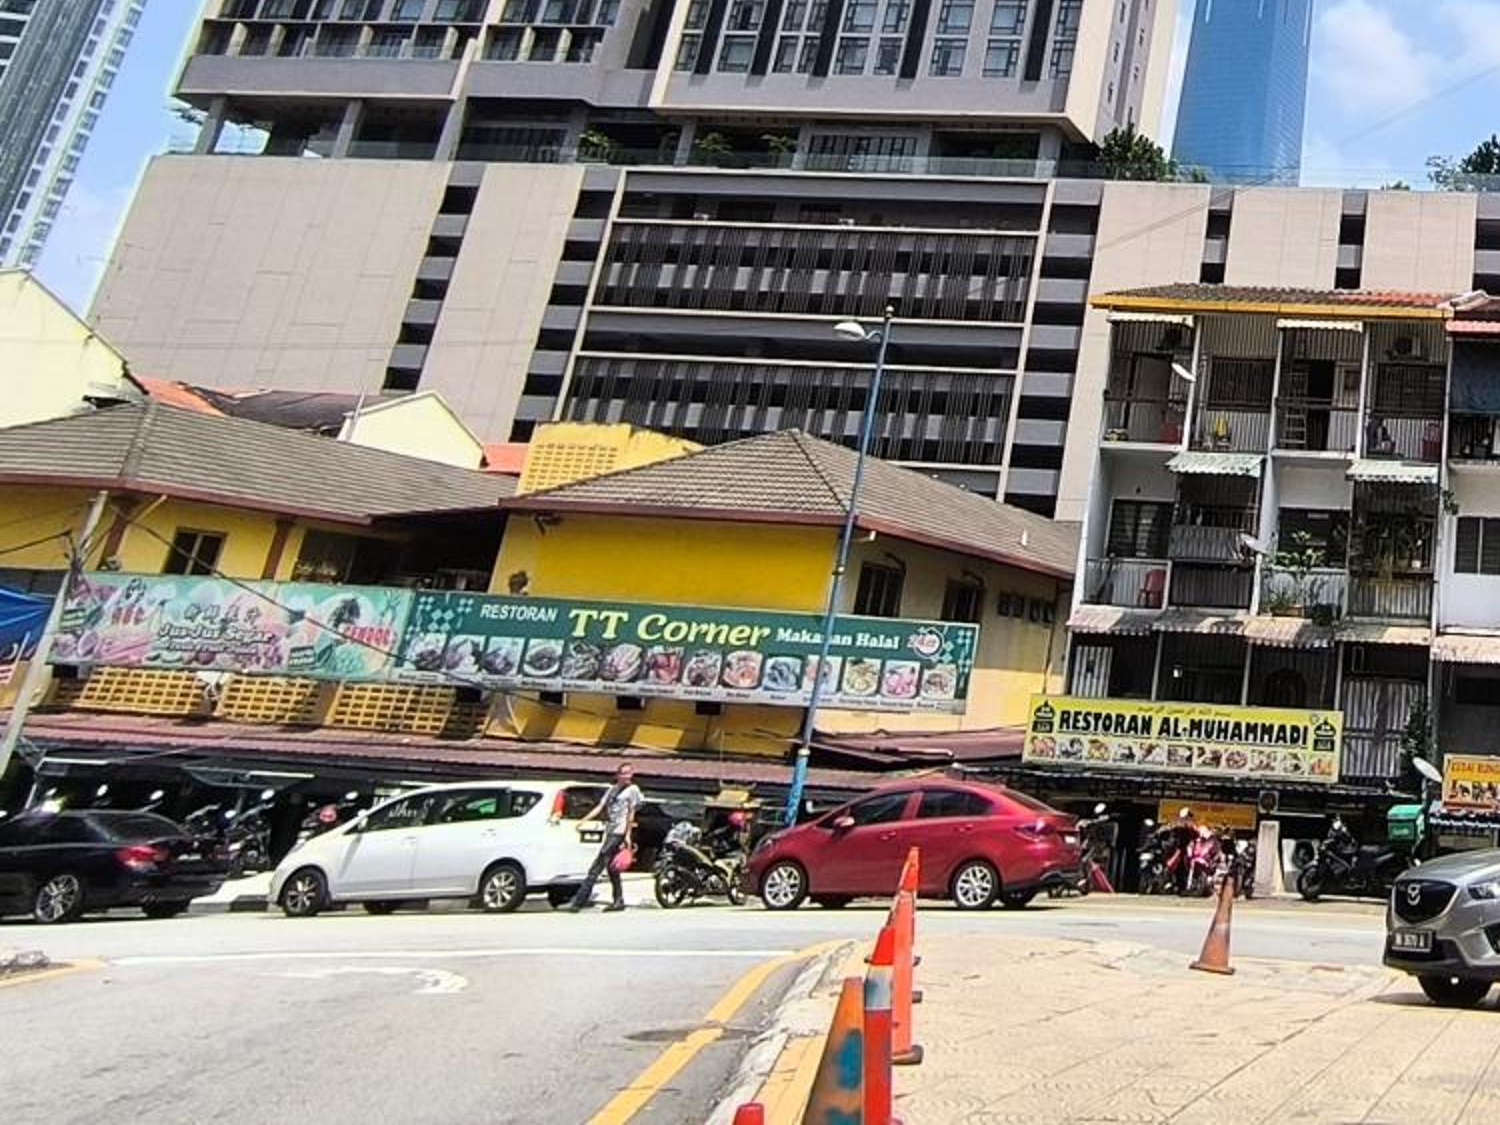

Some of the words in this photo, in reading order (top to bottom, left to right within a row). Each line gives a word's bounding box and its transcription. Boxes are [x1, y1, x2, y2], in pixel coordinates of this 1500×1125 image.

[480, 604, 557, 622] RESTORAN
[569, 609, 628, 639] TT
[636, 614, 770, 646] Corner
[776, 628, 852, 646] Makaan
[855, 634, 899, 649] Halal
[1058, 710, 1152, 736] RESTORAN
[1158, 717, 1309, 746] AL-MUHAMMADI
